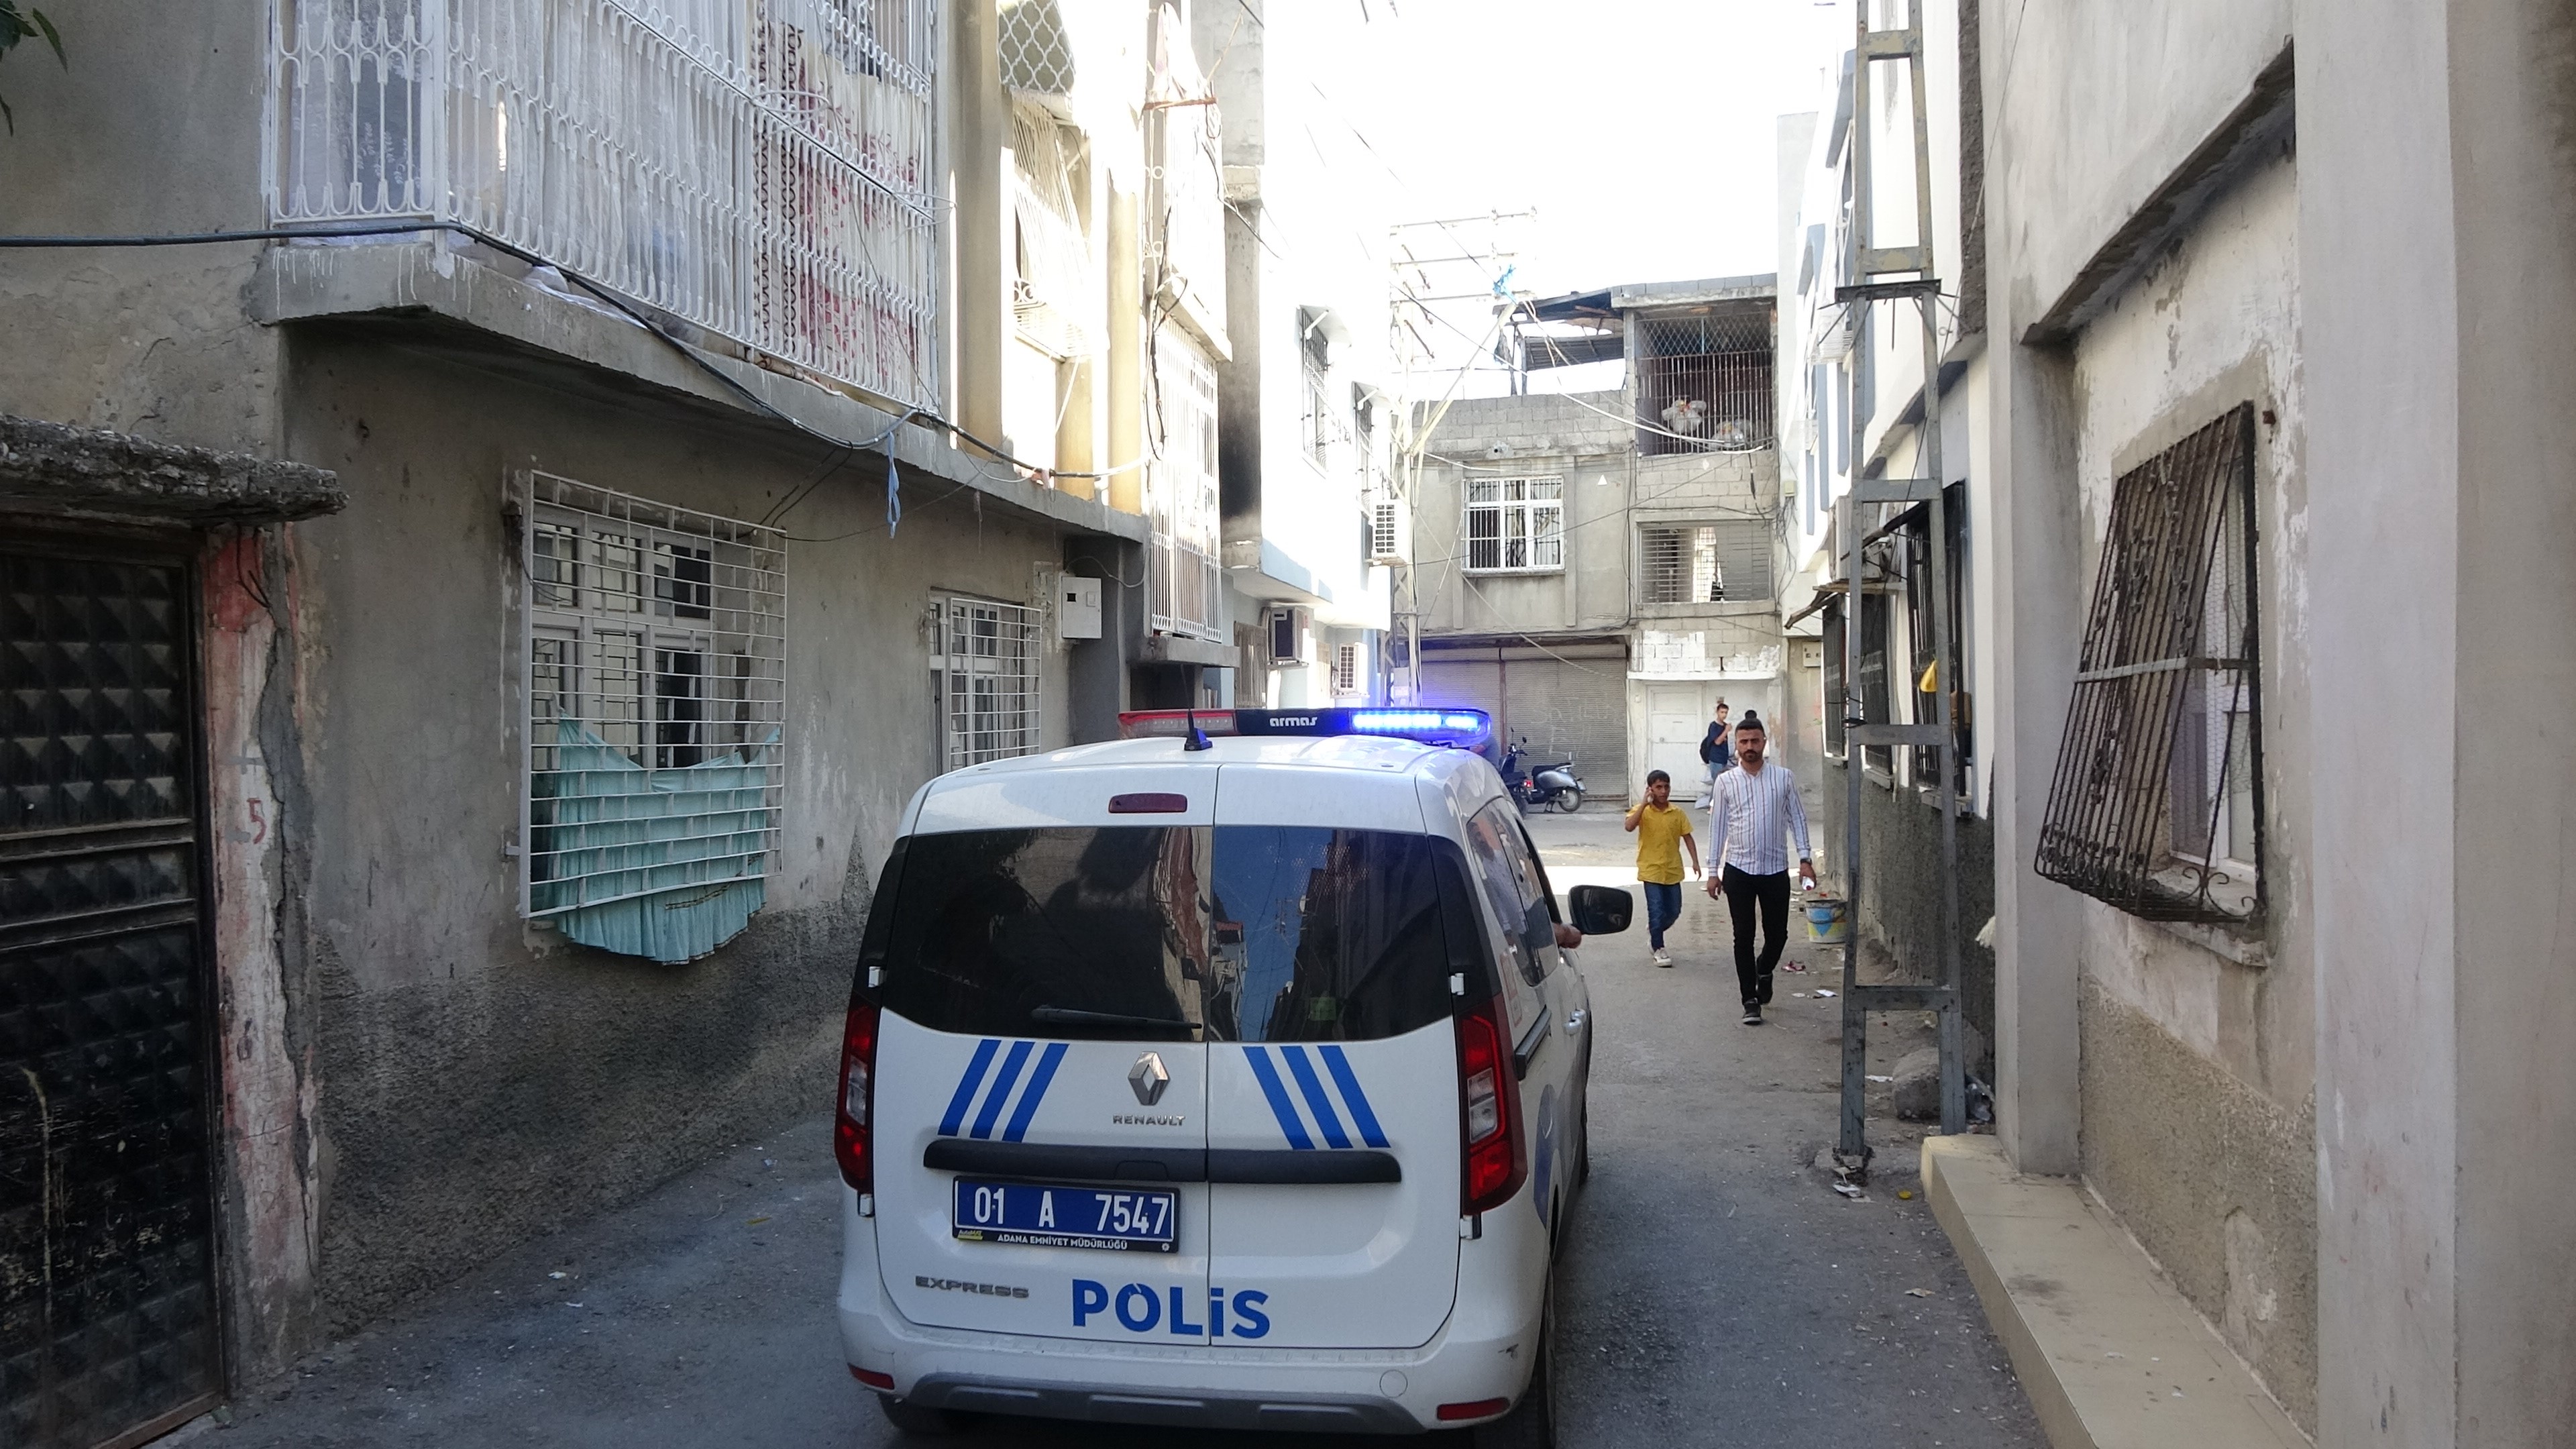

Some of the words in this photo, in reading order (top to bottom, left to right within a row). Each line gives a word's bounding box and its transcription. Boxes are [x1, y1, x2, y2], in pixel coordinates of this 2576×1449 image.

[1269, 716, 1318, 727] armas
[246, 798, 267, 845] 5
[1113, 1115, 1185, 1126] RENAULT
[975, 1187, 1004, 1224] 01
[1038, 1191, 1055, 1228] A
[1095, 1194, 1169, 1234] 7547
[998, 1234, 1028, 1243] ADANA
[1030, 1236, 1069, 1246] EMNİYET
[915, 1275, 1029, 1299] EXPRESS
